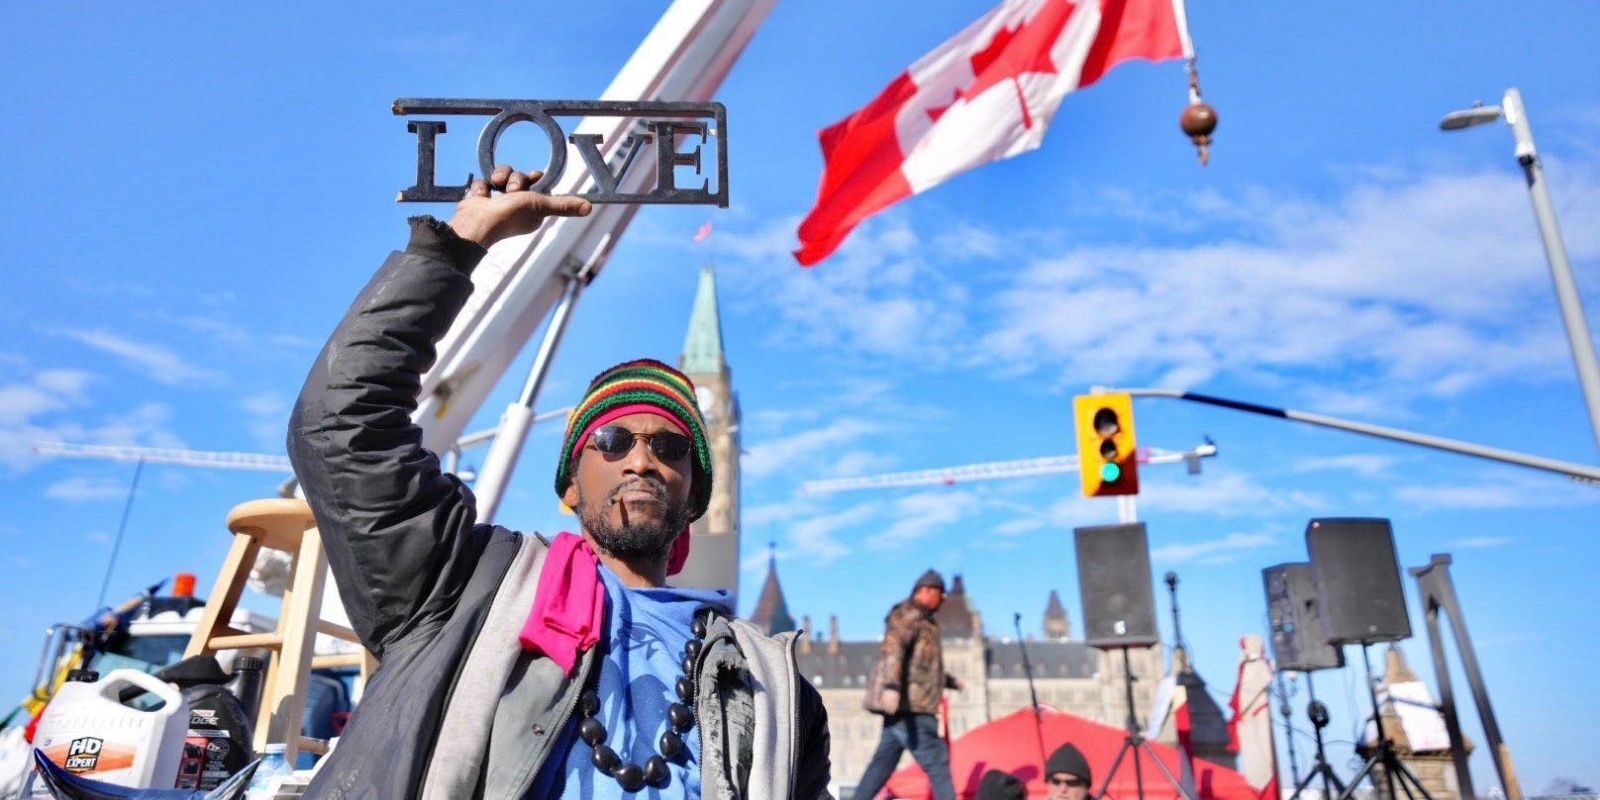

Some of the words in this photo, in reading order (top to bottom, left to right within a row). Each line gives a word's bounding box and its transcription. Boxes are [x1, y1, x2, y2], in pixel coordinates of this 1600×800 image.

[404, 106, 709, 201] LOVE
[70, 738, 101, 755] HD
[66, 758, 96, 768] EXPERT
